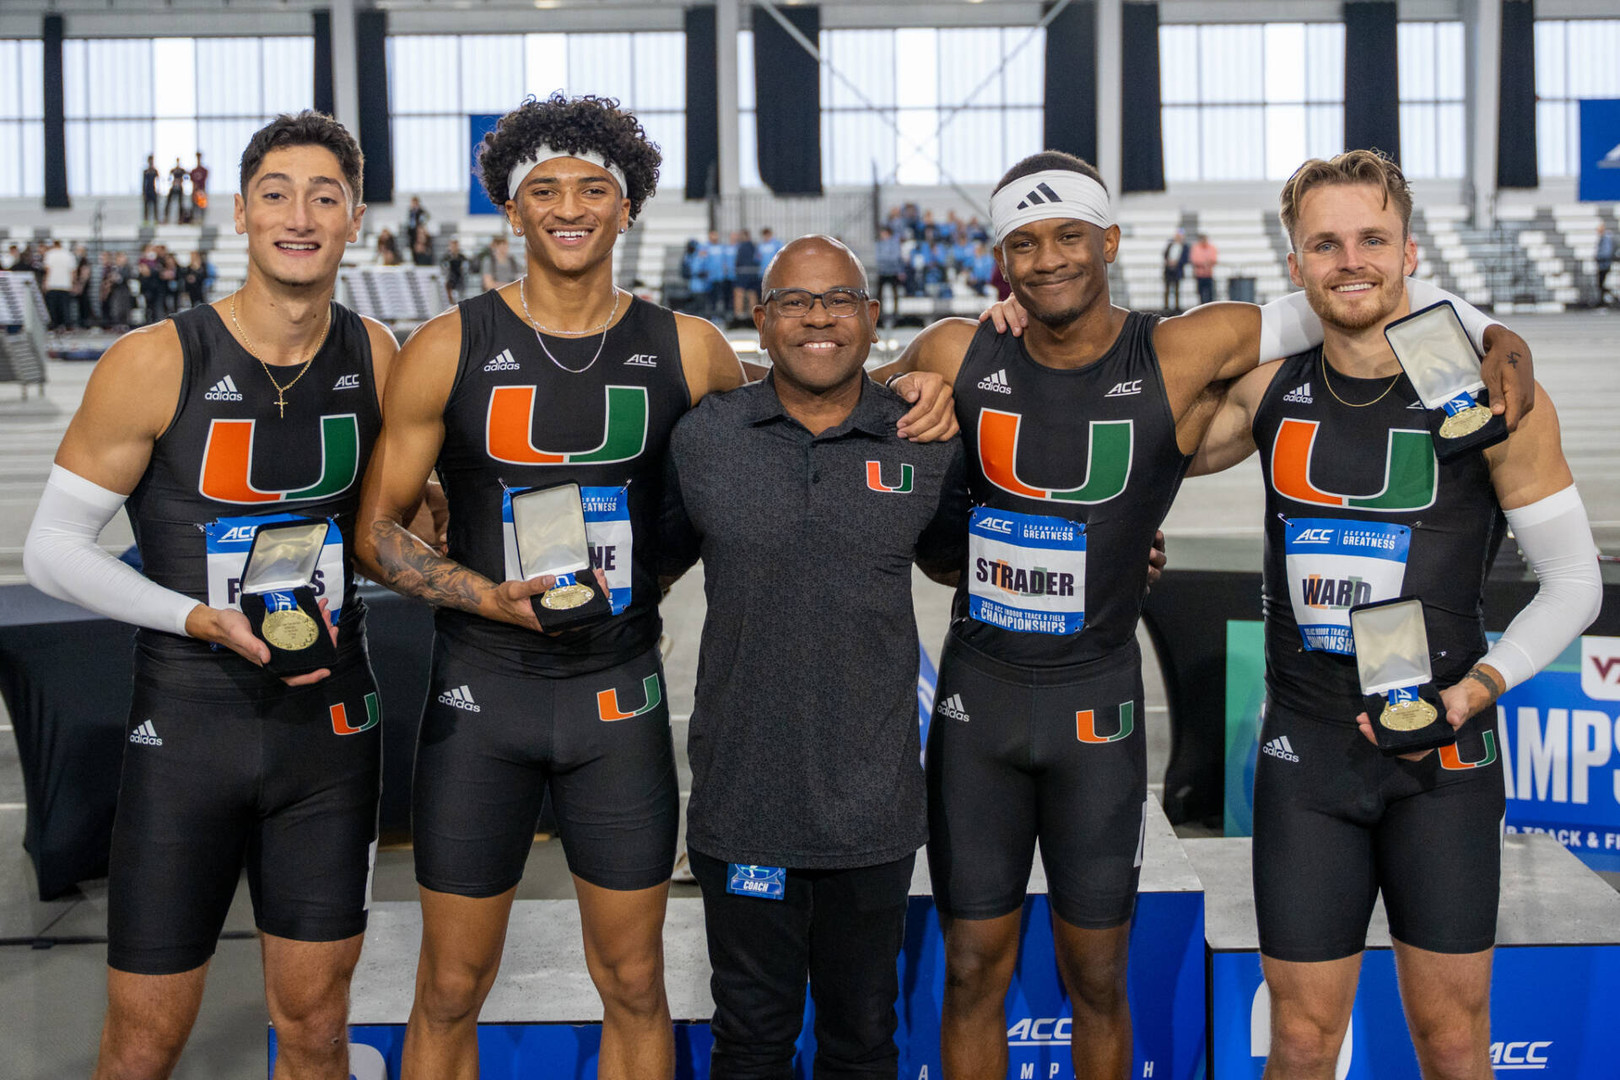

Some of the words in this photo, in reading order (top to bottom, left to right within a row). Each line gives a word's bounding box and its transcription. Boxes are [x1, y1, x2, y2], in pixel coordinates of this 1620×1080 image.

[484, 362, 520, 372] adidas
[625, 354, 657, 366] ACC
[334, 374, 360, 389] ACC
[977, 381, 1012, 395] adidas
[1105, 379, 1143, 396] ACC
[205, 391, 243, 401] adidas
[1283, 394, 1313, 404] adidas
[486, 385, 649, 466] U
[199, 413, 360, 505] U
[977, 407, 1134, 505] U
[1271, 417, 1439, 512] U
[866, 461, 914, 493] U
[977, 517, 1014, 534] ACC
[1023, 530, 1073, 541] GREATNESS
[1294, 529, 1334, 543] ACC
[1343, 536, 1395, 550] GREATNESS
[976, 557, 1074, 596] STRADER
[1302, 578, 1372, 606] WARD
[981, 607, 1066, 633] CHAMPIONSHIPS
[1024, 612, 1041, 620] TRACK
[438, 695, 481, 713] adidas
[597, 673, 661, 722] U
[329, 692, 380, 735] U
[937, 705, 970, 722] adidas
[1076, 700, 1134, 744] U
[129, 734, 163, 746] adidas
[1262, 745, 1300, 763] adidas
[743, 880, 769, 892] COACH
[1007, 1018, 1073, 1041] ACC
